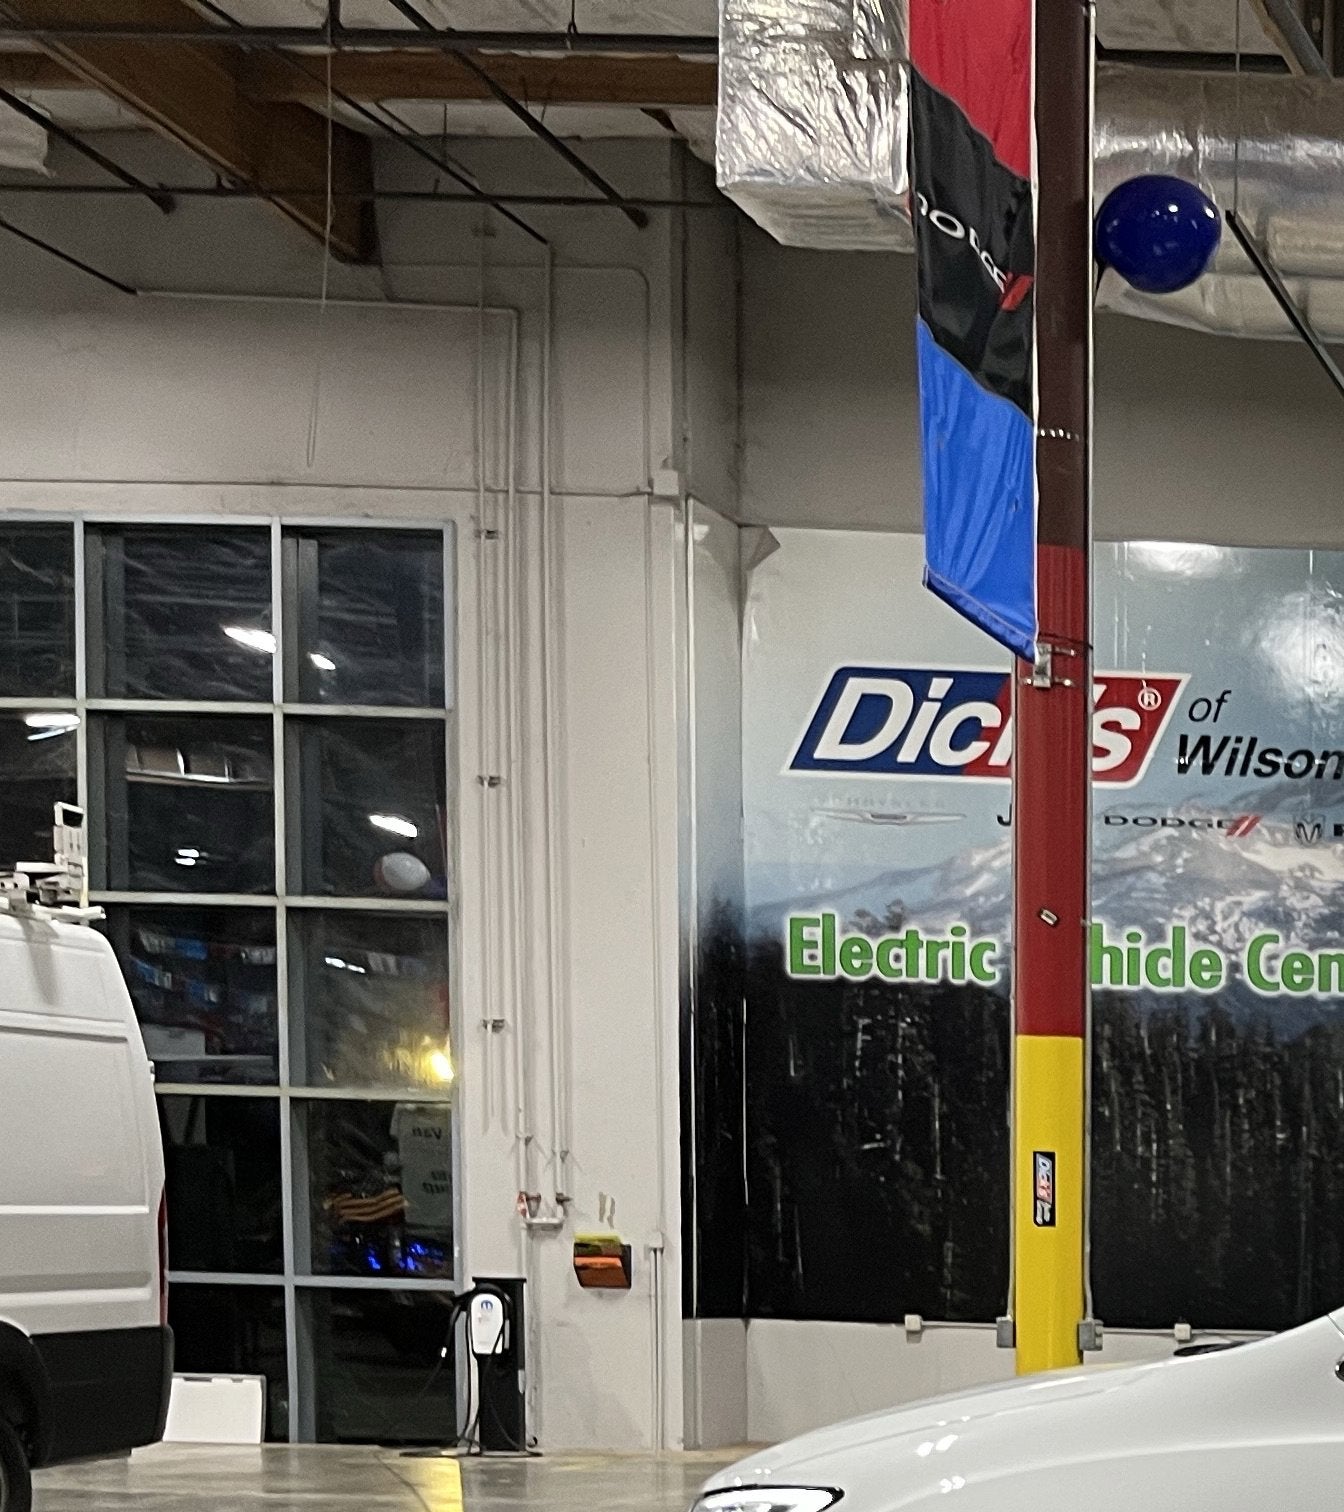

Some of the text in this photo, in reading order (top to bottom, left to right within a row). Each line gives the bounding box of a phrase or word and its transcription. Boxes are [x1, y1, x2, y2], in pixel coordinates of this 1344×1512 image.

[1188, 689, 1232, 723] of
[789, 912, 997, 982] Electric
[1091, 922, 1223, 990] hicle
